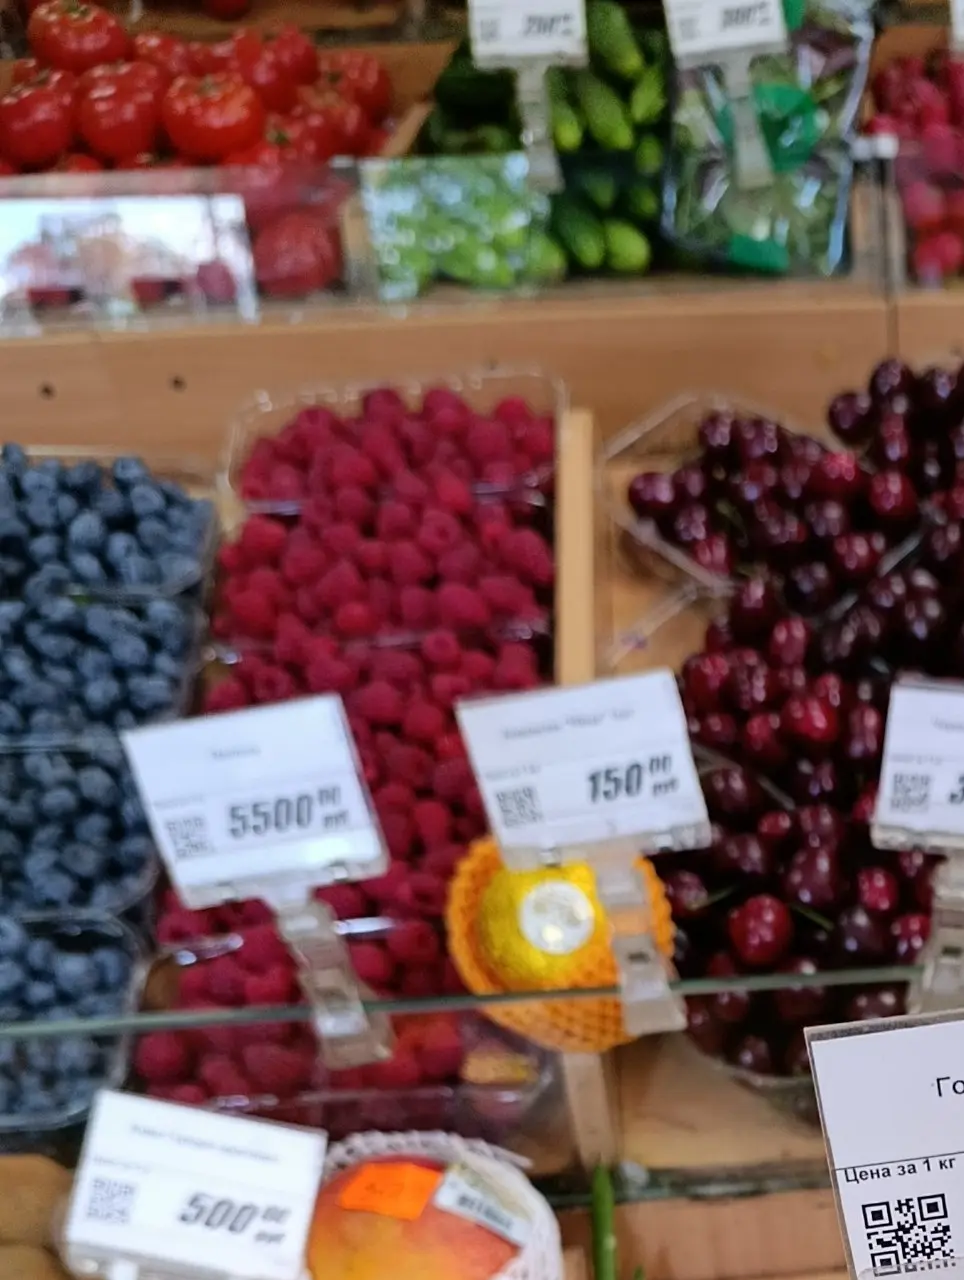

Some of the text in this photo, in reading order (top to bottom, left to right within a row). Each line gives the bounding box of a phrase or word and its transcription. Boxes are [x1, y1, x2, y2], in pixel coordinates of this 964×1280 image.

[588, 763, 643, 803] 150
[228, 794, 313, 838] 5500
[843, 1157, 957, 1184] Цена за 1 кг
[179, 1192, 260, 1234] 500
